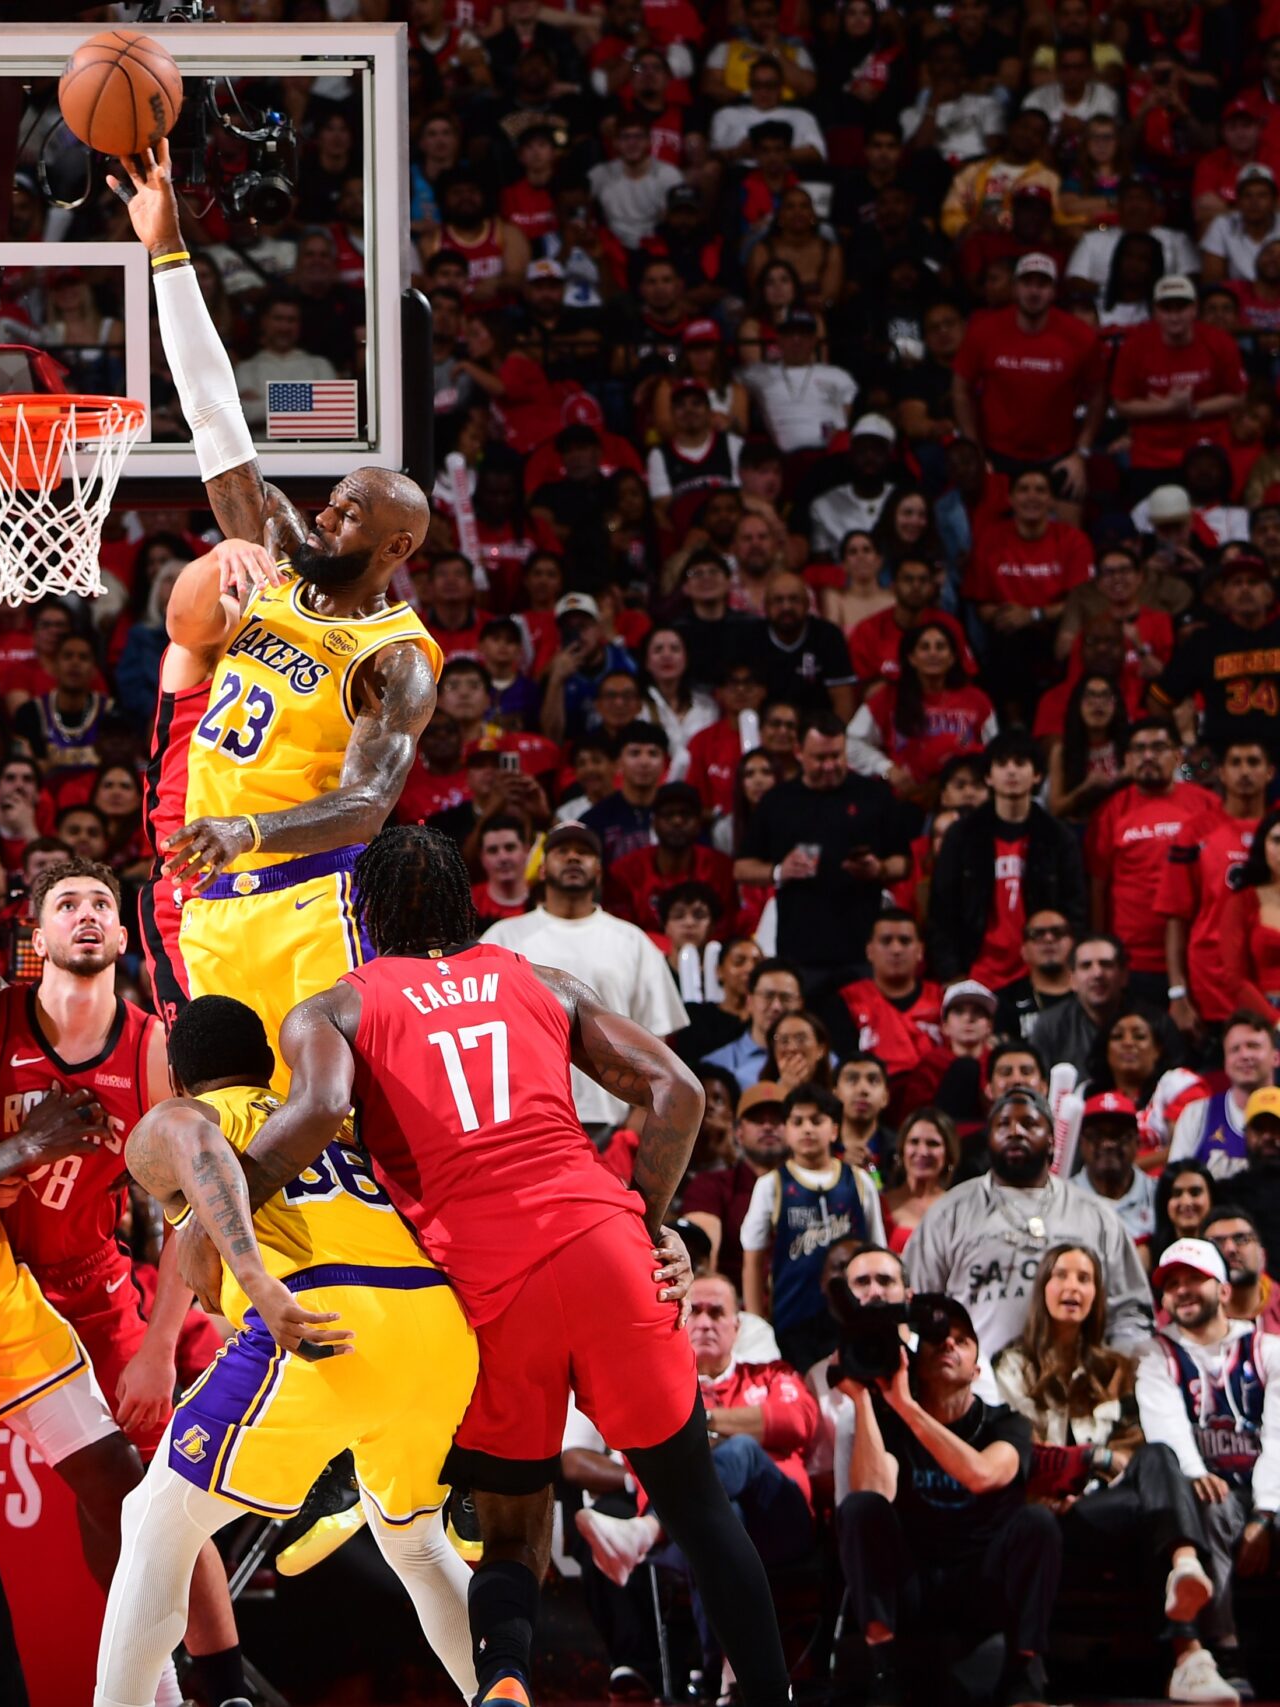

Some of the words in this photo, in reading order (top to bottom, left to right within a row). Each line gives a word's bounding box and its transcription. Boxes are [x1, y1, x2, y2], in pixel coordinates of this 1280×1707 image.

[225, 613, 333, 697] LAKERS
[329, 631, 355, 653] bibigo
[196, 670, 276, 767] 23
[401, 973, 500, 1015] EASON
[427, 1020, 511, 1133] 17
